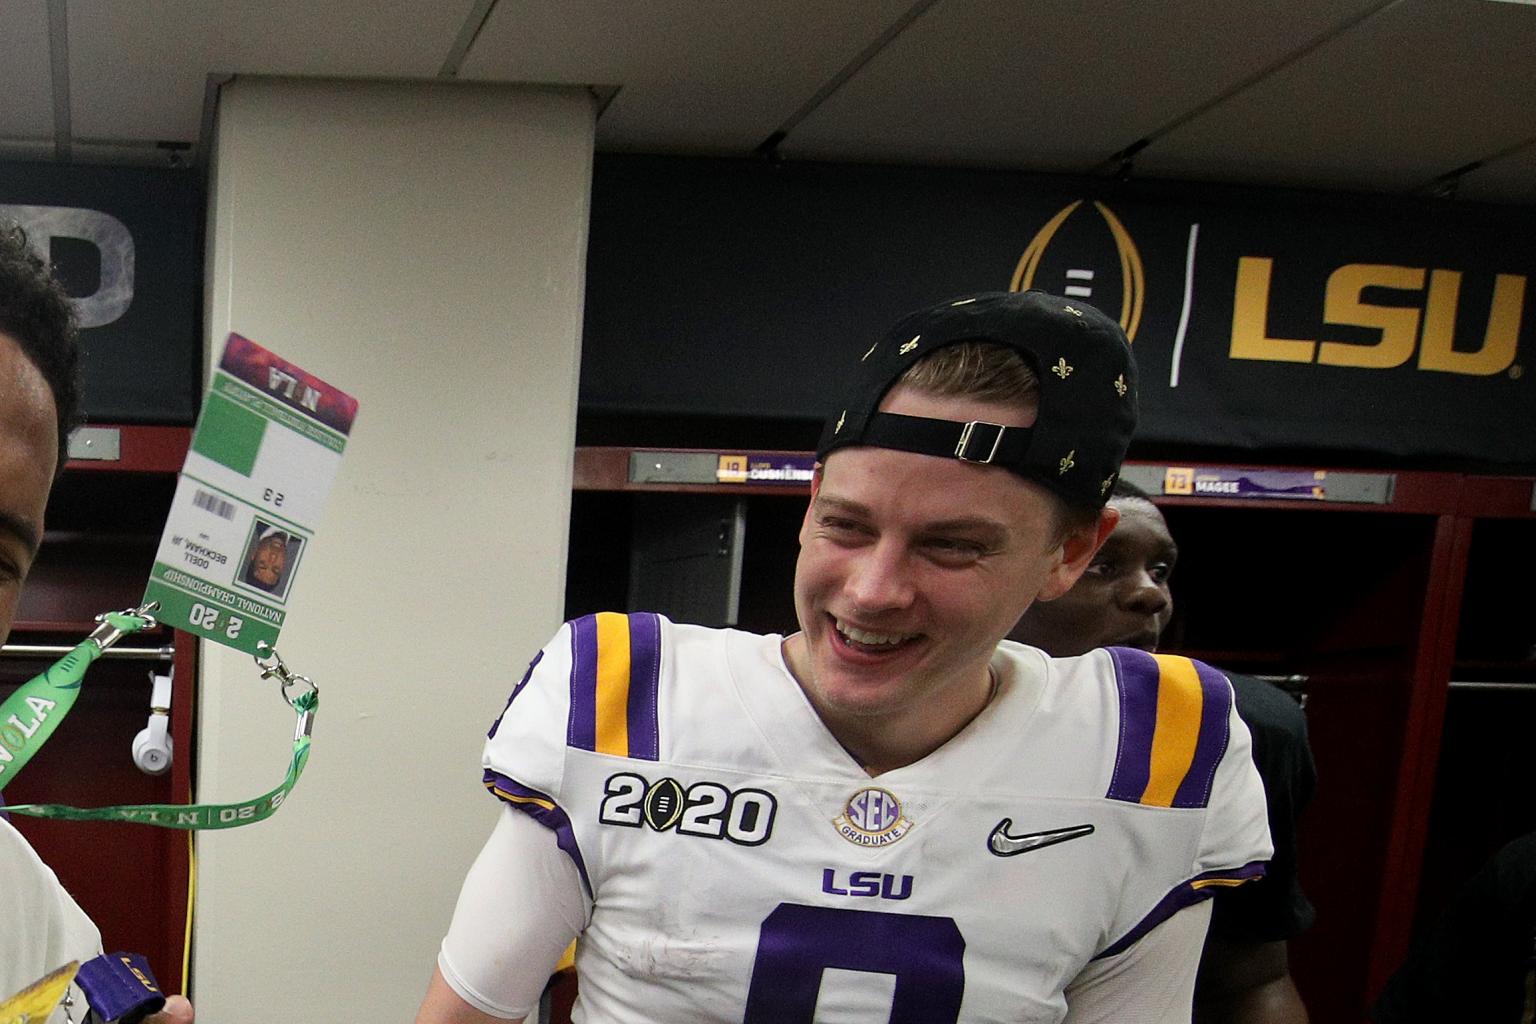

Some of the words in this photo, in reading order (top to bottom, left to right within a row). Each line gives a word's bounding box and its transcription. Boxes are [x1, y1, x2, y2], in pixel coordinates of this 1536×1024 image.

[1228, 256, 1528, 376] LSU
[1195, 480, 1241, 494] MAGEE
[164, 569, 236, 604] CHAMPIONSHIP
[237, 598, 282, 623] NATIONAL
[599, 772, 778, 847] 2020
[850, 789, 896, 831] SEC
[841, 825, 902, 846] GRADUATE
[822, 867, 914, 900] LSU
